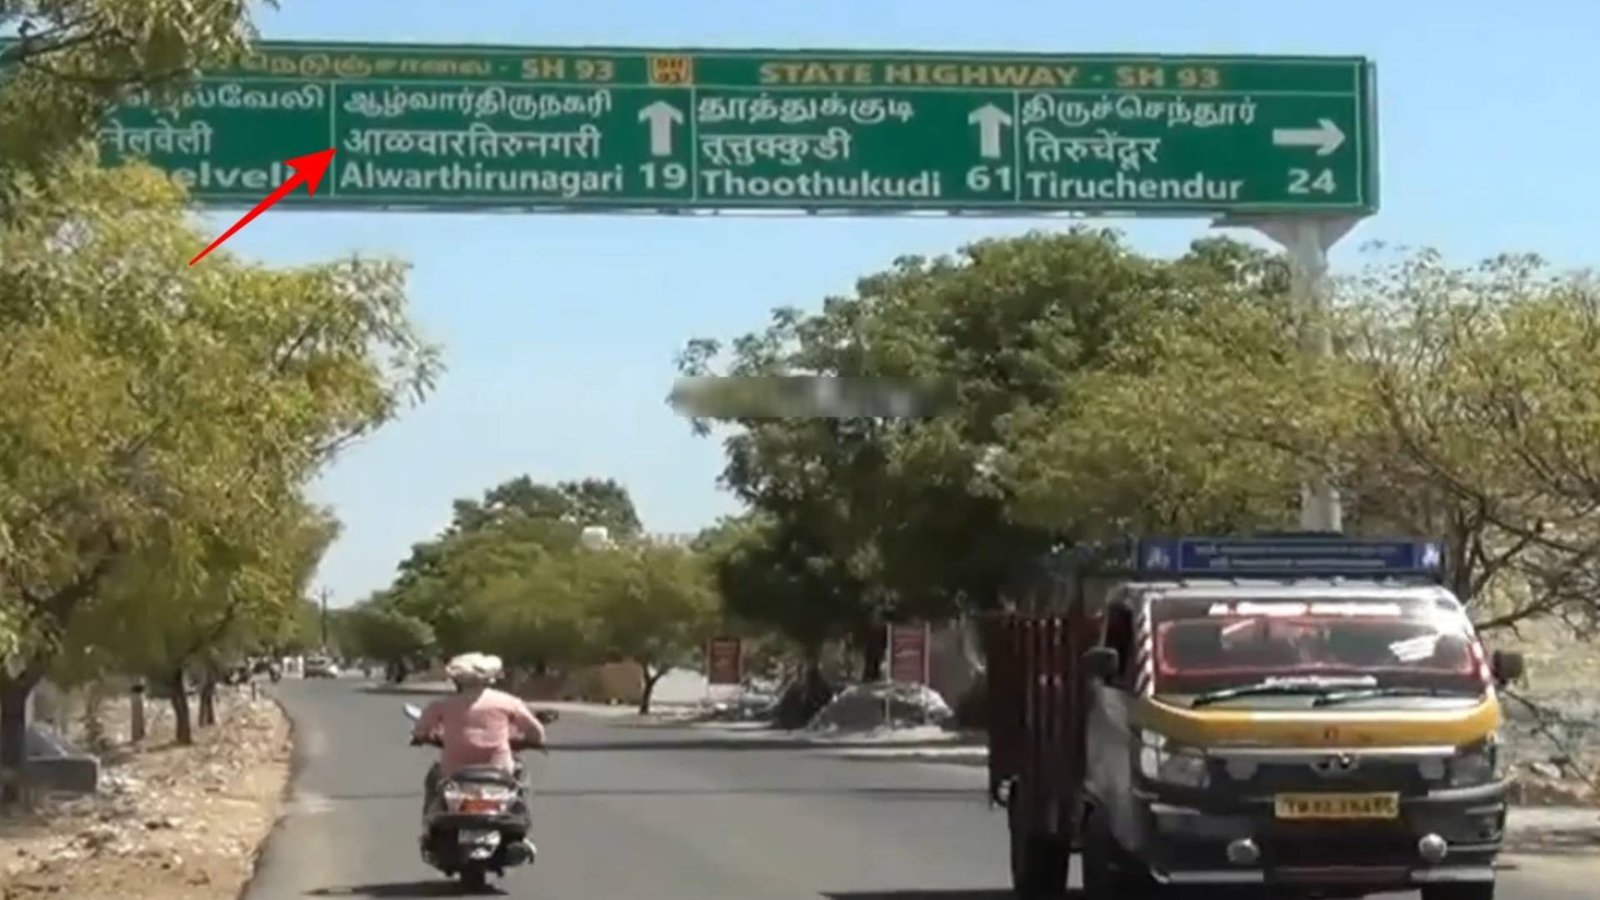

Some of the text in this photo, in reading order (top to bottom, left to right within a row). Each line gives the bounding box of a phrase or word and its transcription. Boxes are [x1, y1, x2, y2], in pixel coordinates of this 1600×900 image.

[520, 57, 566, 80] SH
[575, 58, 615, 81] 93
[759, 62, 873, 84] STATE
[886, 64, 1079, 87] HIGHWAY
[1115, 66, 1165, 88] SH
[1176, 67, 1220, 88] 93
[339, 160, 688, 198] Alwarthirunagari 19
[700, 165, 1012, 198] Thoothukudi 61
[1026, 168, 1338, 200] Tiruchendur 24
